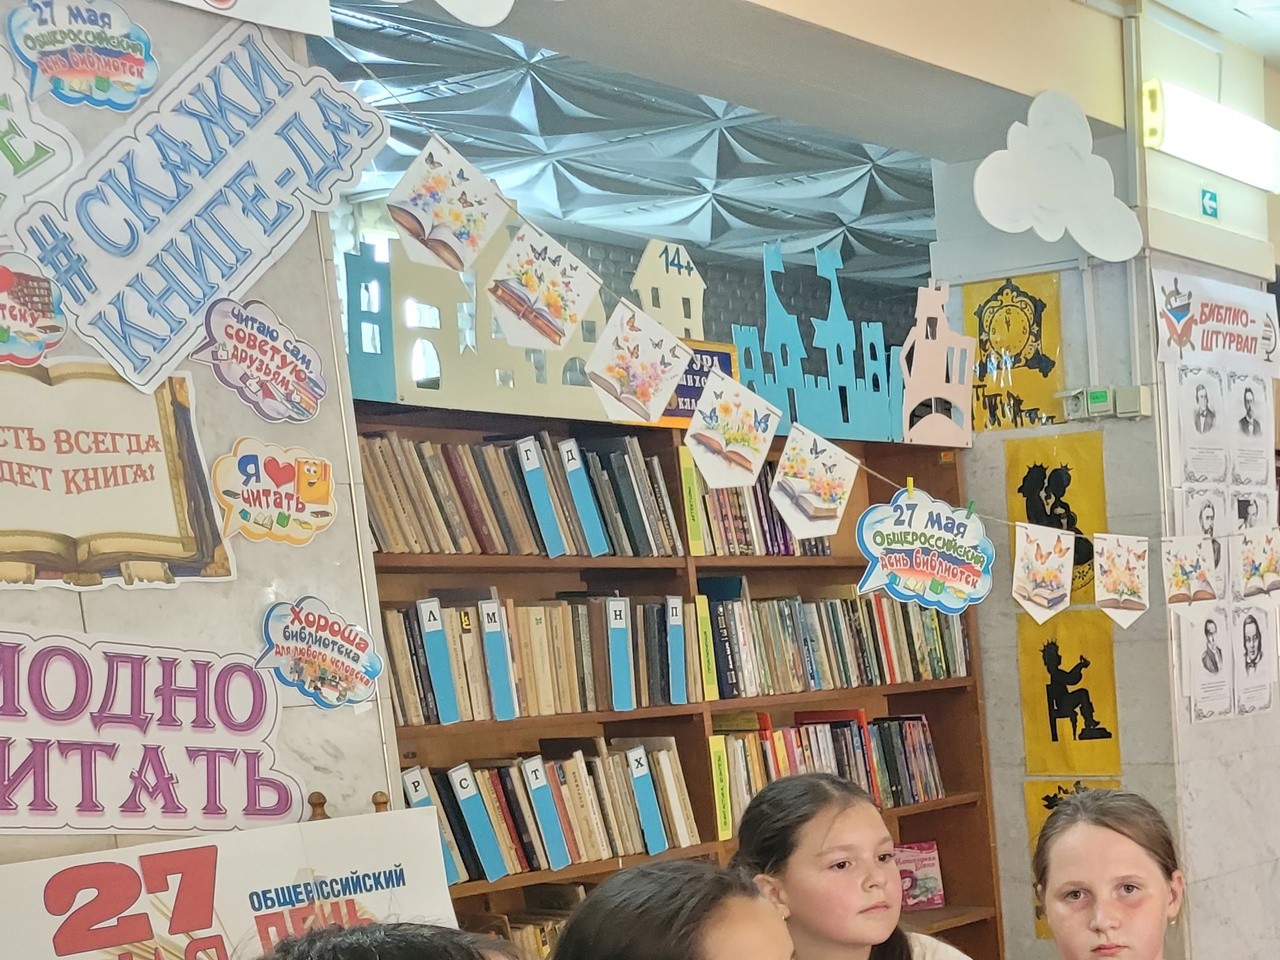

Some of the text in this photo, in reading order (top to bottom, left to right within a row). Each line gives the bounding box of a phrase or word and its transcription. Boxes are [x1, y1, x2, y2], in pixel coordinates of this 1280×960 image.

[28, 34, 293, 306] #СКАЖИ
[89, 88, 374, 374] КНИГЕ-ДА
[659, 244, 694, 277] 14+
[1199, 302, 1256, 328] БИБЛИО-
[1201, 329, 1258, 354] ШТУРВАЛ
[53, 429, 162, 455] ВСЕГДА
[524, 449, 532, 461] Г
[565, 450, 577, 463] Д
[62, 463, 155, 495] КНИГА!
[238, 454, 261, 486] Я
[893, 504, 918, 529] 27
[913, 549, 979, 589] библиотек
[427, 610, 438, 622] Л
[487, 612, 498, 624] М
[613, 608, 623, 620] Н
[670, 606, 679, 618] П
[283, 625, 360, 663] библиотека
[530, 769, 540, 781] Т
[634, 757, 645, 769] Х
[411, 780, 421, 793] Р
[459, 778, 470, 790] С
[248, 863, 407, 912] ОБЩЕРССИЙСКИЙ
[43, 845, 218, 957] 27
